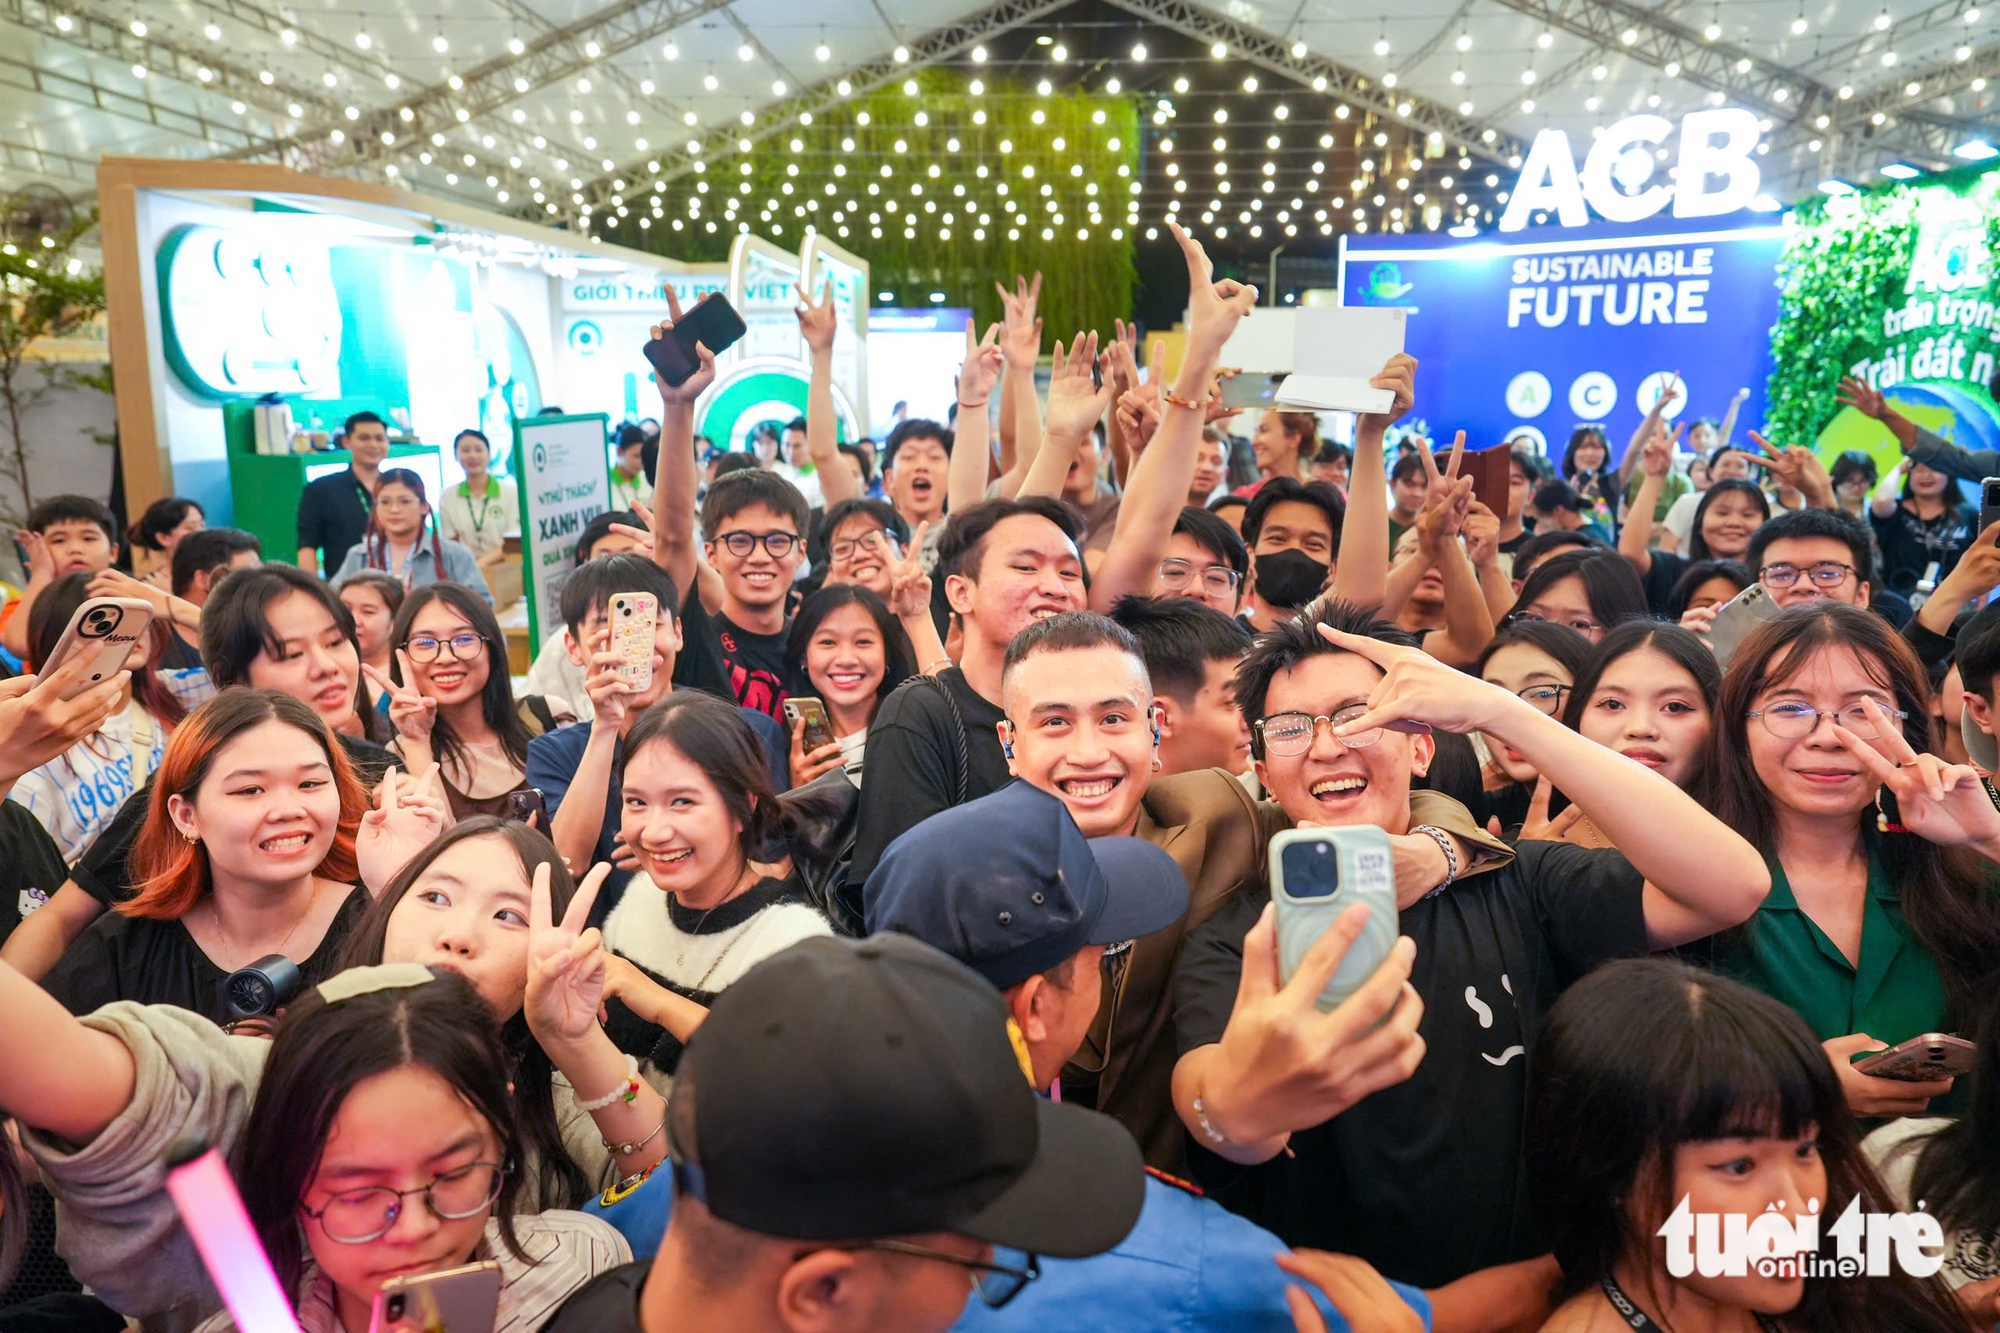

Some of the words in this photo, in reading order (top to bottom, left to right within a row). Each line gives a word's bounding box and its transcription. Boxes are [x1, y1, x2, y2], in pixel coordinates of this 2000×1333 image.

[1499, 107, 1761, 232] ACB
[1511, 247, 1714, 284] SUSTAINABLE
[573, 277, 617, 301] GIỚI
[1507, 279, 1710, 328] FUTURE
[1882, 296, 1934, 338] trân
[1850, 342, 1907, 392] Trái
[1911, 331, 1967, 380] đất
[1519, 385, 1536, 404] A
[1584, 386, 1601, 406] C
[539, 511, 578, 541] XANH
